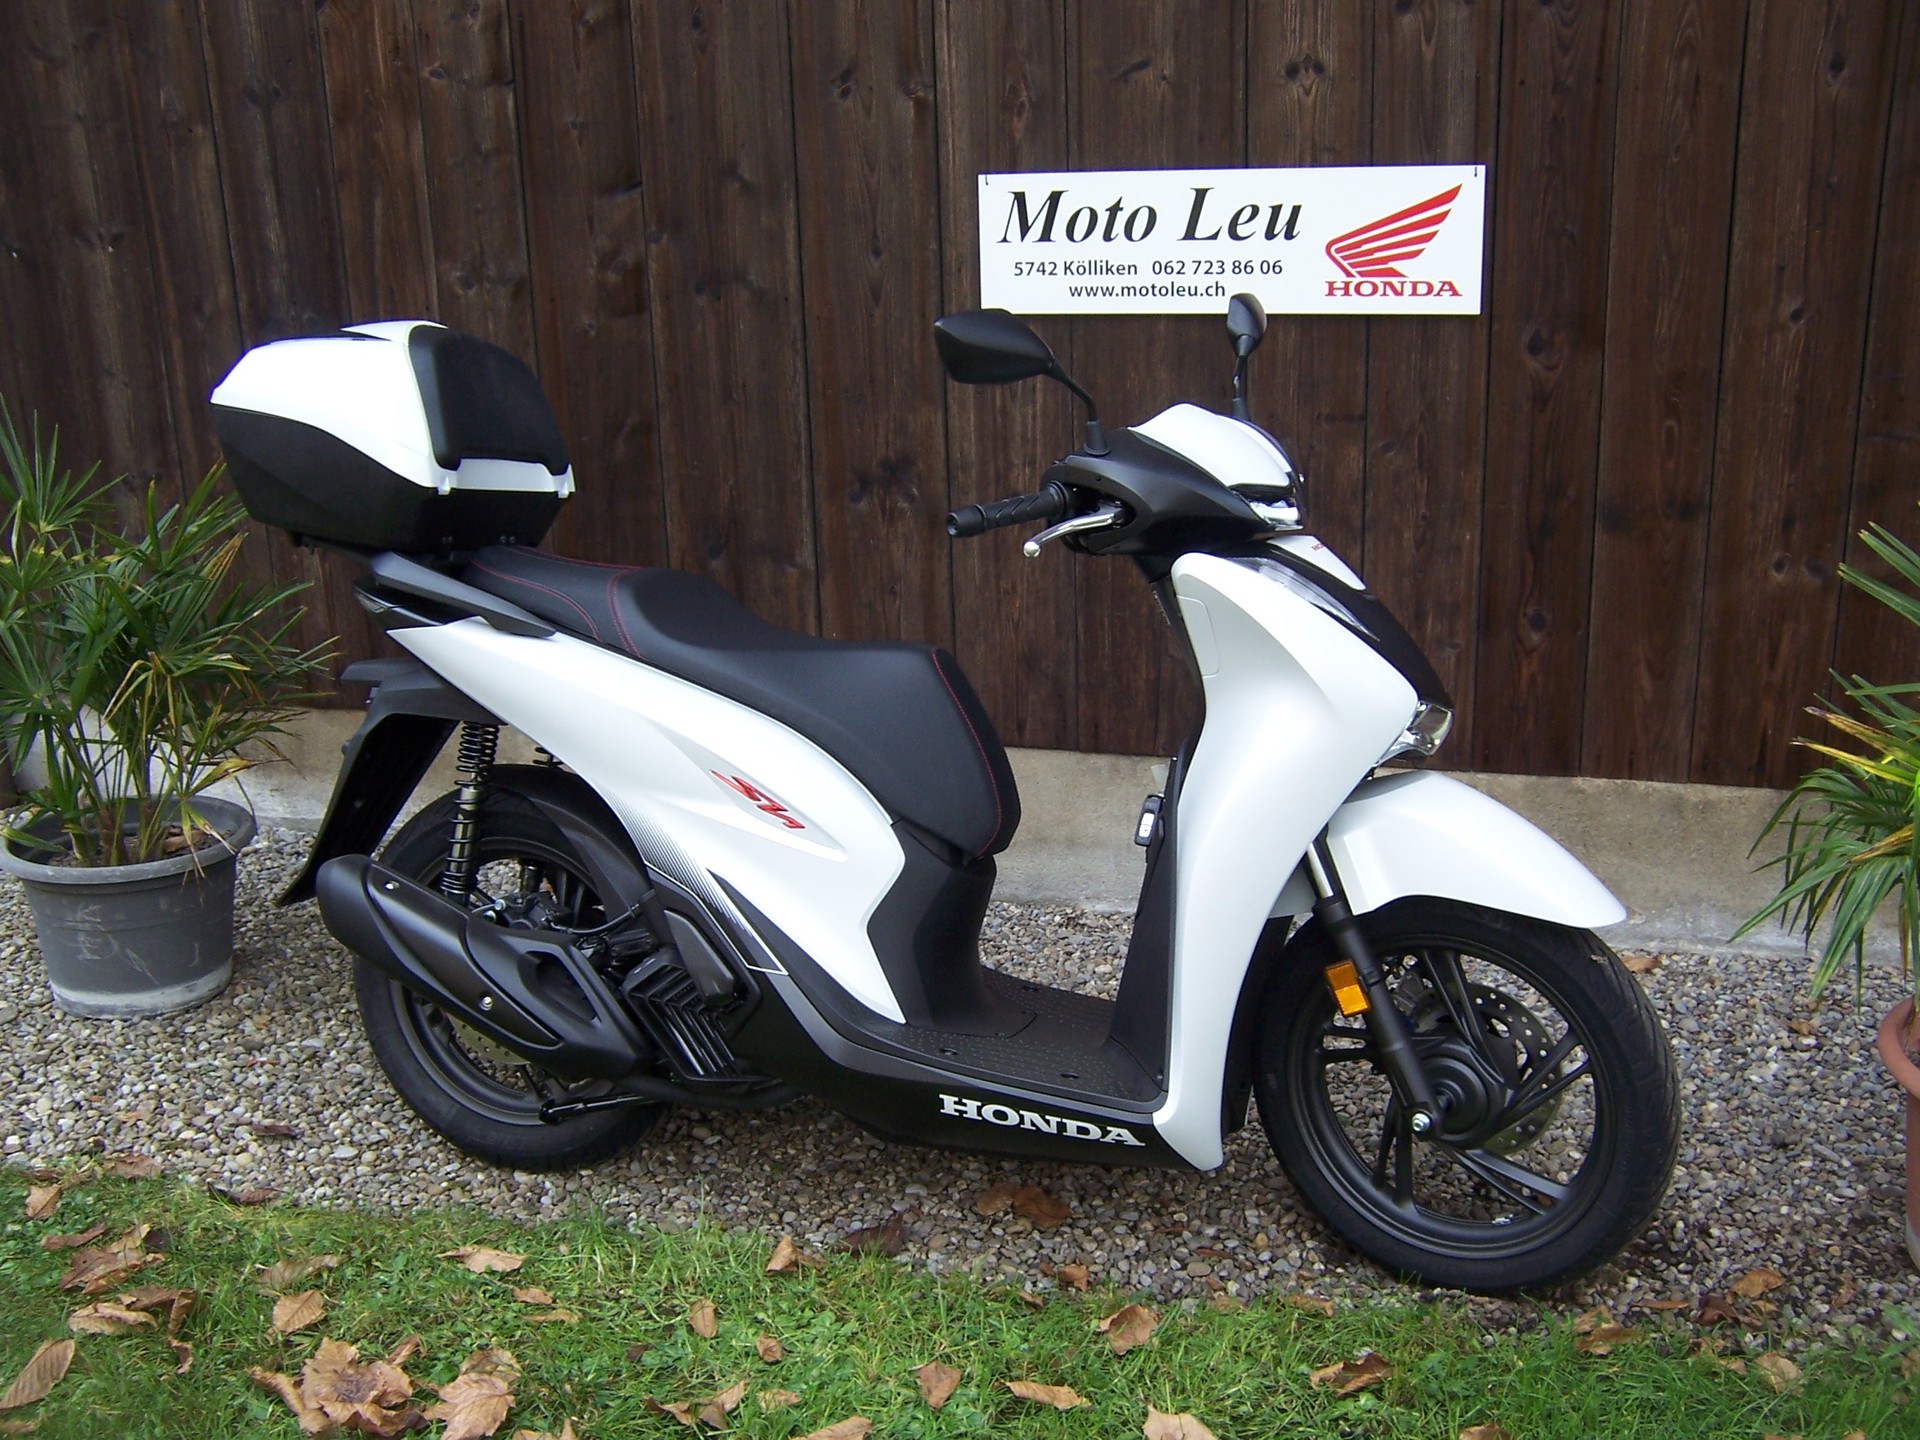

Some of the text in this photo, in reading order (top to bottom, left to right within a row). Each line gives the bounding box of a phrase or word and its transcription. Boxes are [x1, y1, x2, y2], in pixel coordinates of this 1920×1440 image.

[997, 187, 1303, 244] Moto Leu
[1014, 259, 1283, 277] 5742 Kölliken 062 723 86 06
[1069, 281, 1226, 298] www.motoleu.ch
[1324, 280, 1463, 298] HONDA
[939, 1093, 1146, 1147] HONDA
